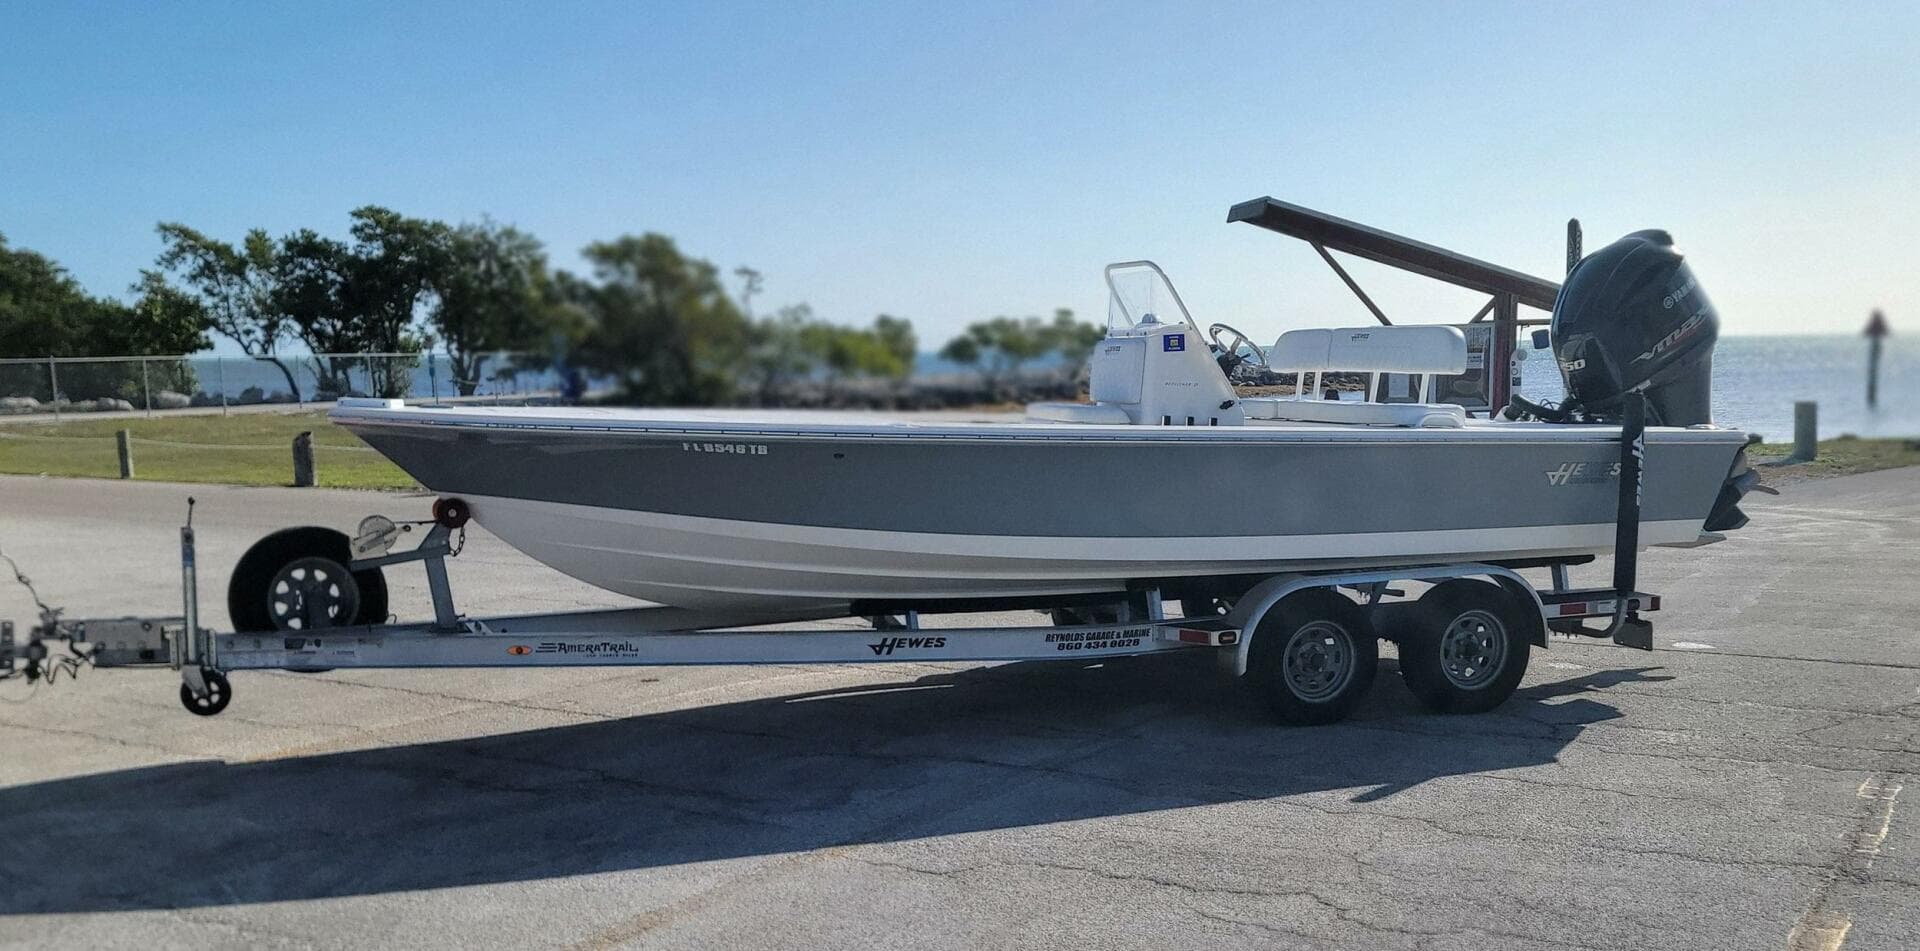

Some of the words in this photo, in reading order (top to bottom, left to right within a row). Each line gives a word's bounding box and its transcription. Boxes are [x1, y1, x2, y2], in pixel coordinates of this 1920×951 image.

[1545, 462, 1622, 486] HES
[1045, 632, 1085, 642] REYNOLDS
[1086, 631, 1115, 640] GARAGE
[1122, 628, 1151, 638] MARINE
[867, 637, 947, 656] HEWES
[1057, 642, 1082, 651] 860
[1084, 641, 1108, 650] 434
